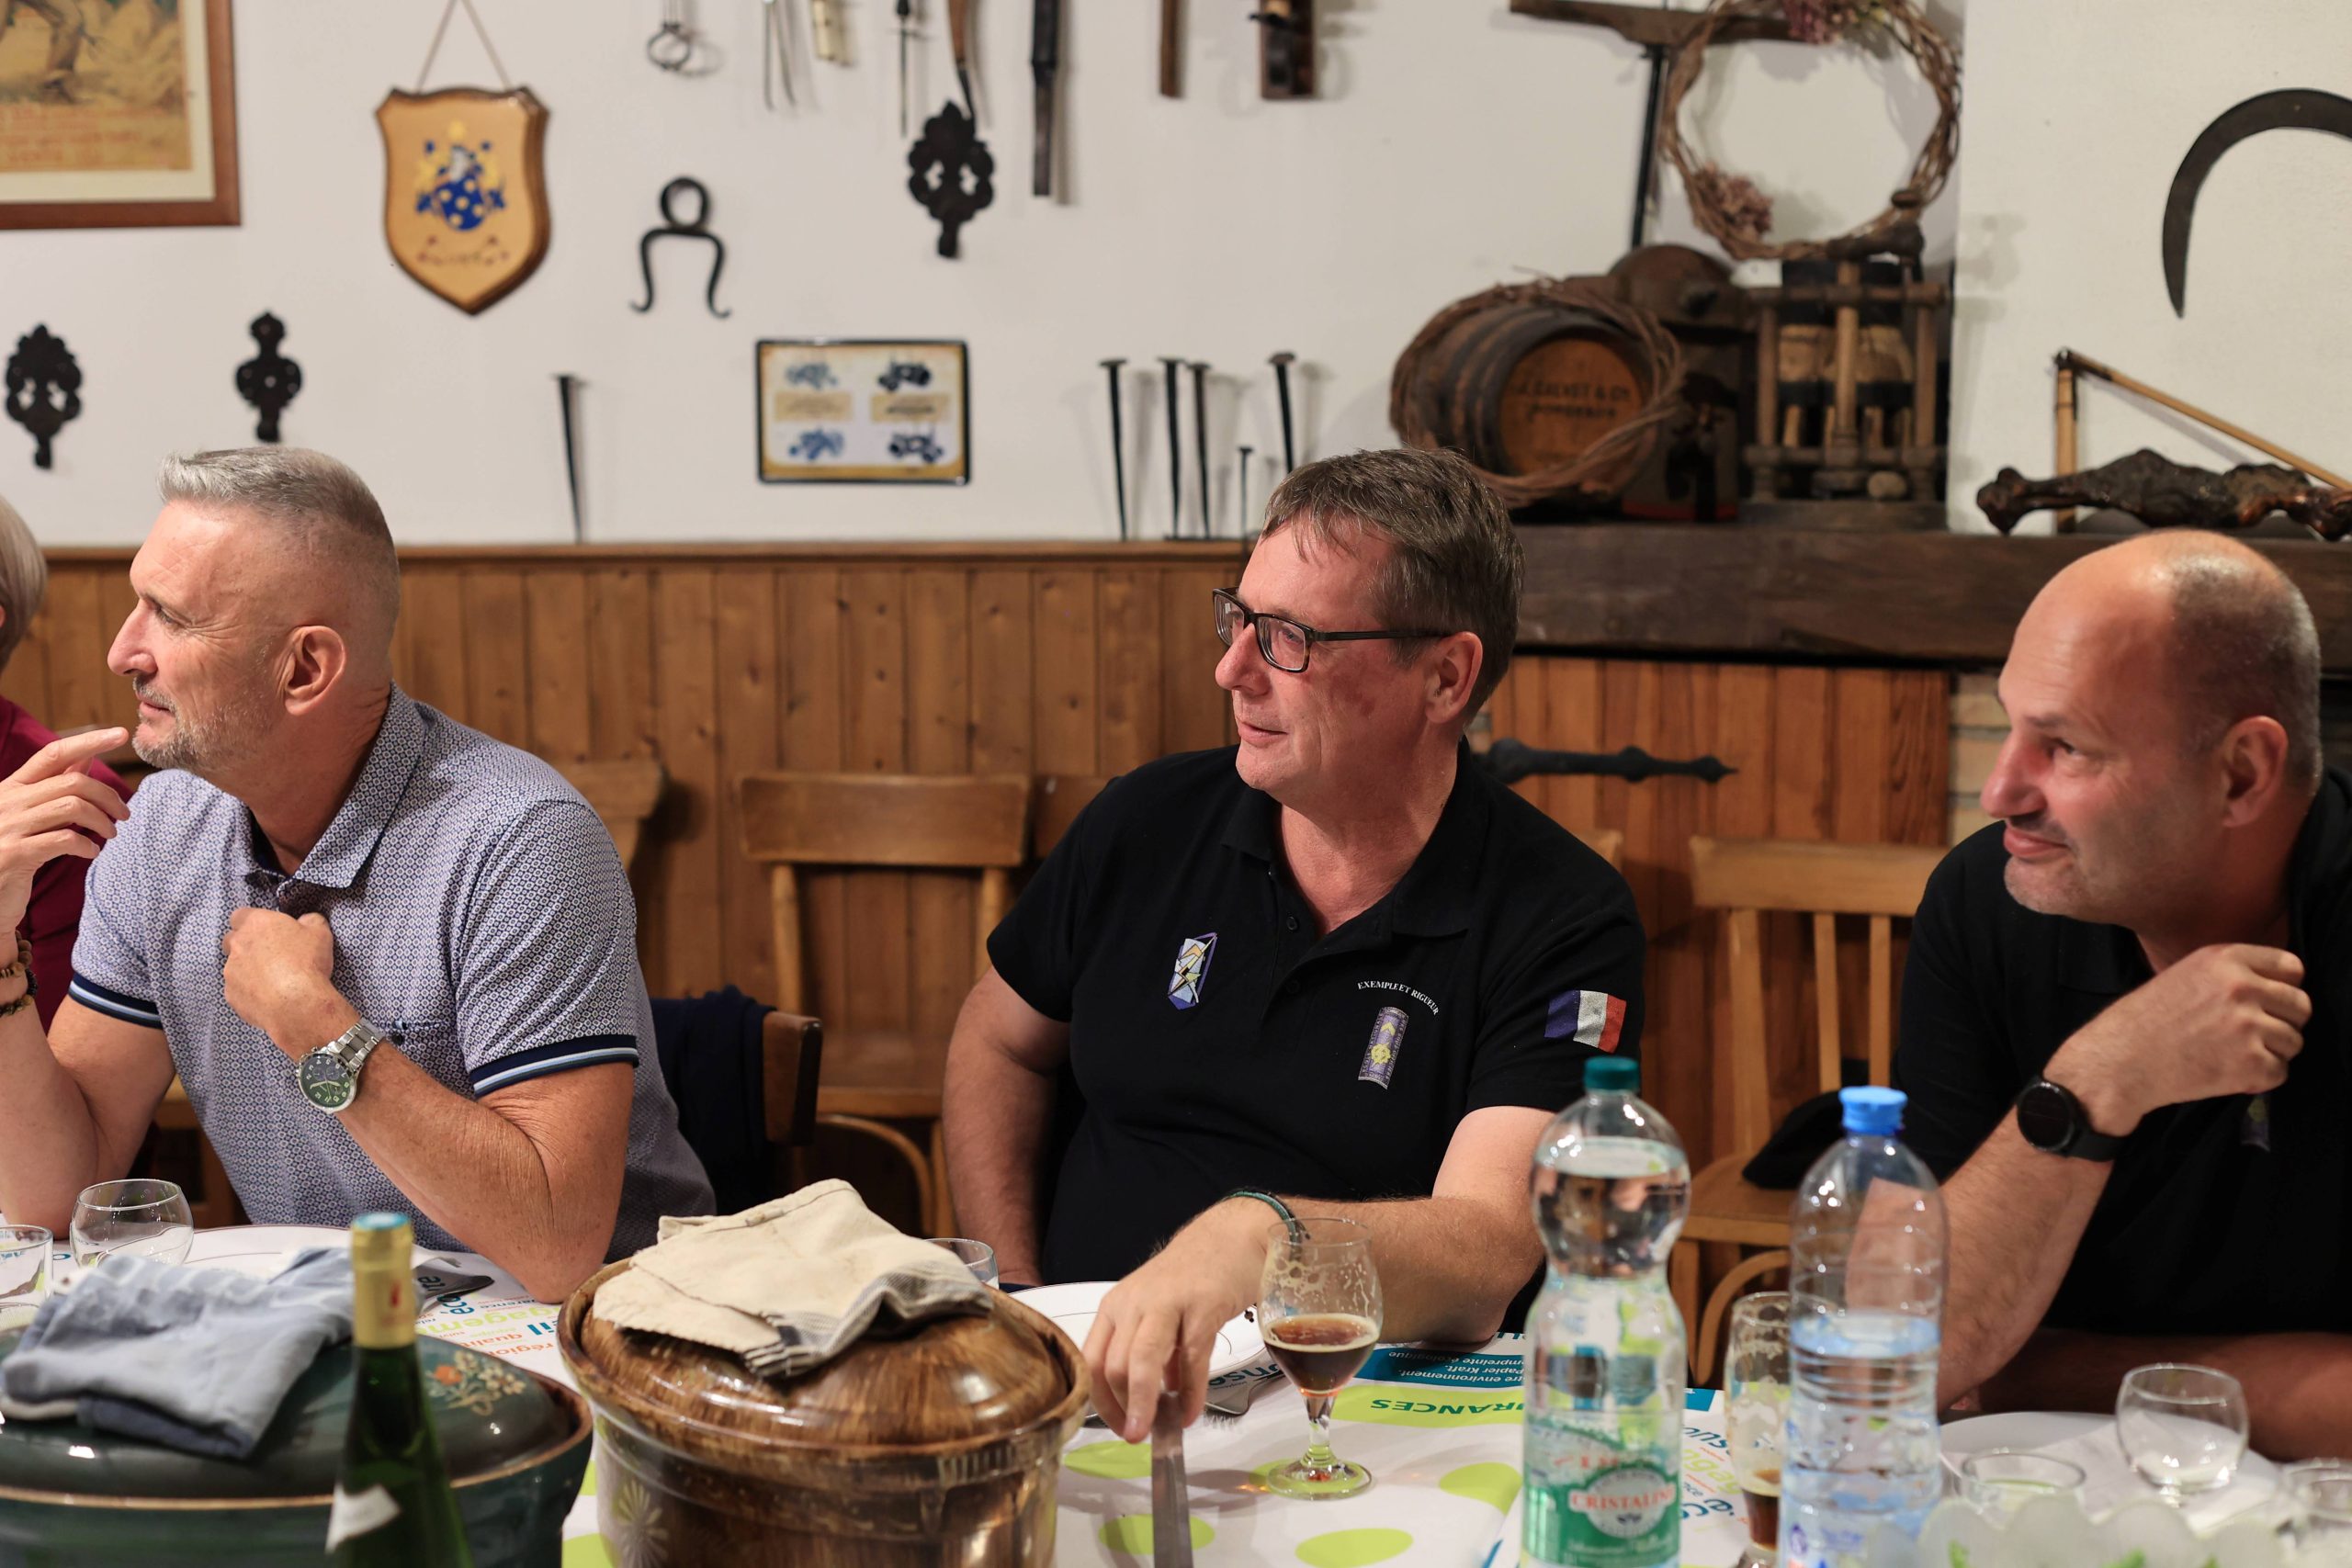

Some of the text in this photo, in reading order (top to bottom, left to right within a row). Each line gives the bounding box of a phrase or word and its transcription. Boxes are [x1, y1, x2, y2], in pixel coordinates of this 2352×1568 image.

[1357, 980, 1440, 1016] EXEMPLE ET RIGUEUR
[1388, 1351, 1525, 1367] mpreinte écologique
[1398, 1369, 1501, 1382] environnement.
[1444, 1364, 1525, 1376] Papier Kraft.
[1571, 1486, 1674, 1511] CRISTALIN
